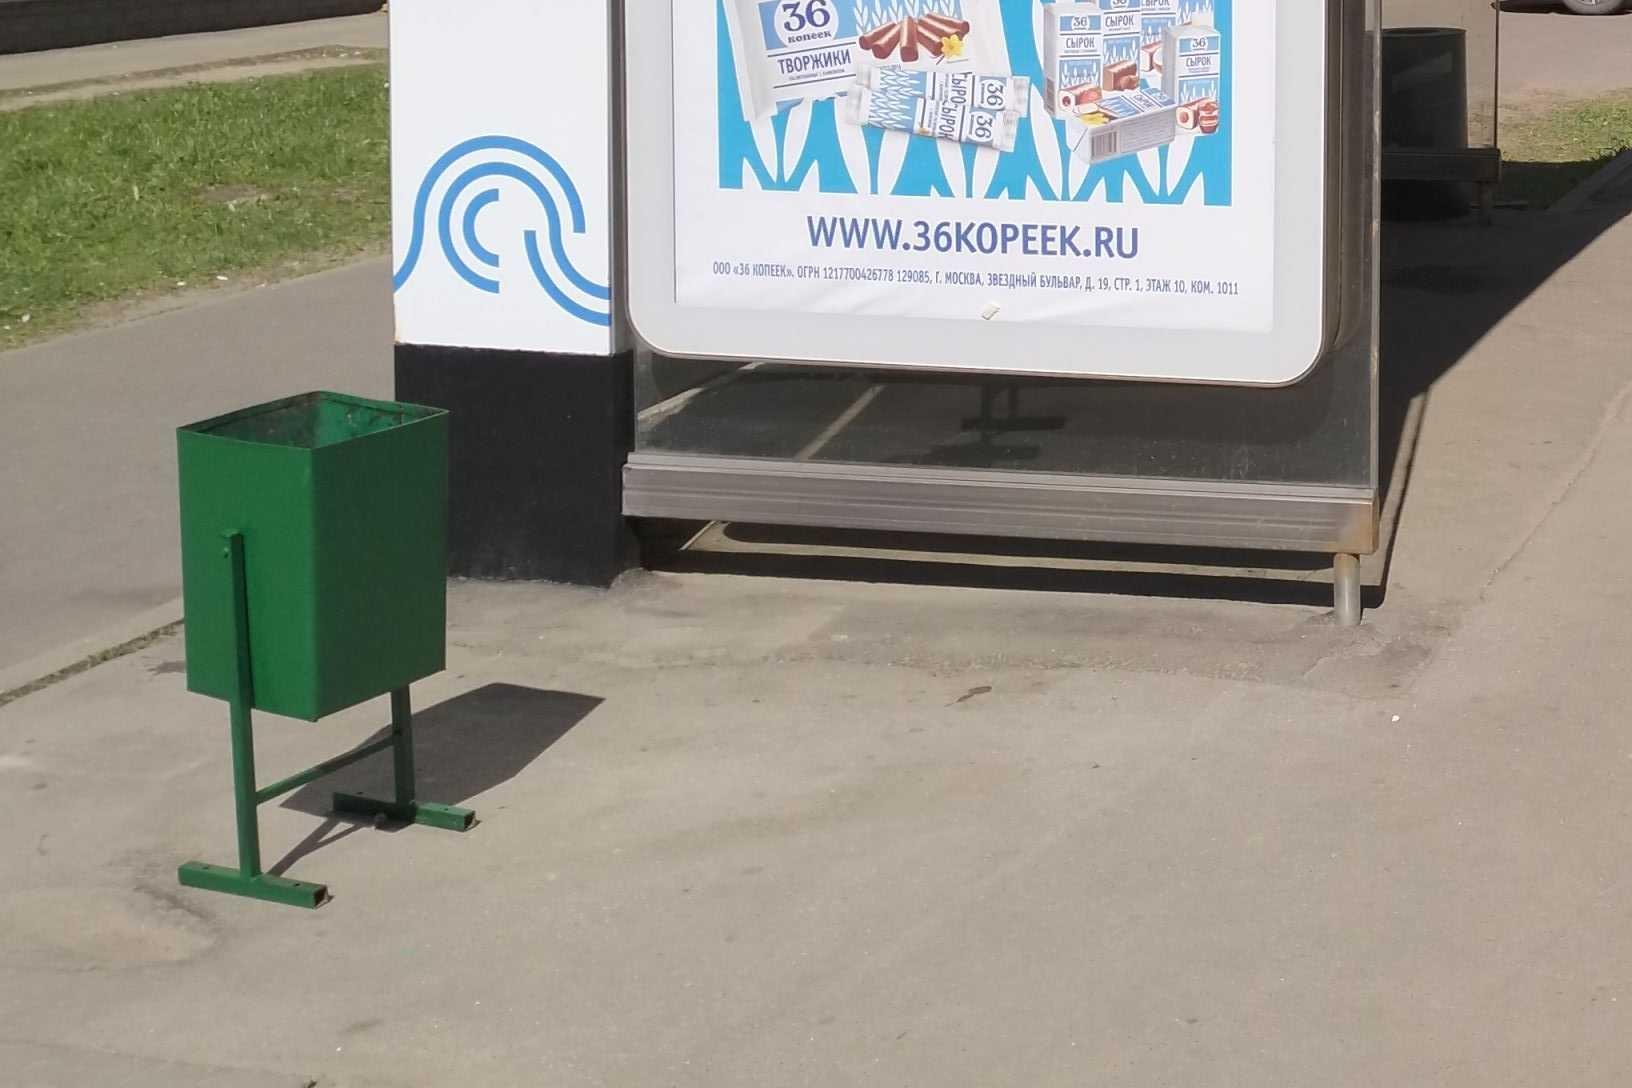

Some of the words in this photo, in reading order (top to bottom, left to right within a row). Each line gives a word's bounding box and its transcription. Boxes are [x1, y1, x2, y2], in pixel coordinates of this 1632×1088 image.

[1073, 17, 1087, 27] 36
[1105, 15, 1134, 28] СЫРОК
[788, 31, 832, 43] копеек
[1066, 37, 1095, 49] СЫРОК
[1192, 37, 1206, 48] 36
[777, 49, 851, 74] ТВОРЖИКИ
[1186, 56, 1211, 67] СЫРОК
[987, 83, 1004, 107] 36
[975, 115, 993, 139] 36
[807, 215, 1139, 259] WWW.36KOPEEK.RU
[713, 261, 731, 274] ООО
[797, 265, 820, 279] ОГРН
[823, 266, 894, 282] 1217700426778
[897, 269, 933, 285] 129085,
[945, 271, 984, 286] МОСКВА,
[987, 272, 1036, 289] ЗВЕЗДНЫЙ
[1040, 274, 1083, 290] БУЛЬВАР,
[1114, 277, 1132, 291] СТР.
[1145, 278, 1171, 292] ЭТАЖ
[1174, 279, 1187, 294] 10,
[1191, 280, 1213, 294] КОМ.
[1217, 281, 1238, 295] 1011
